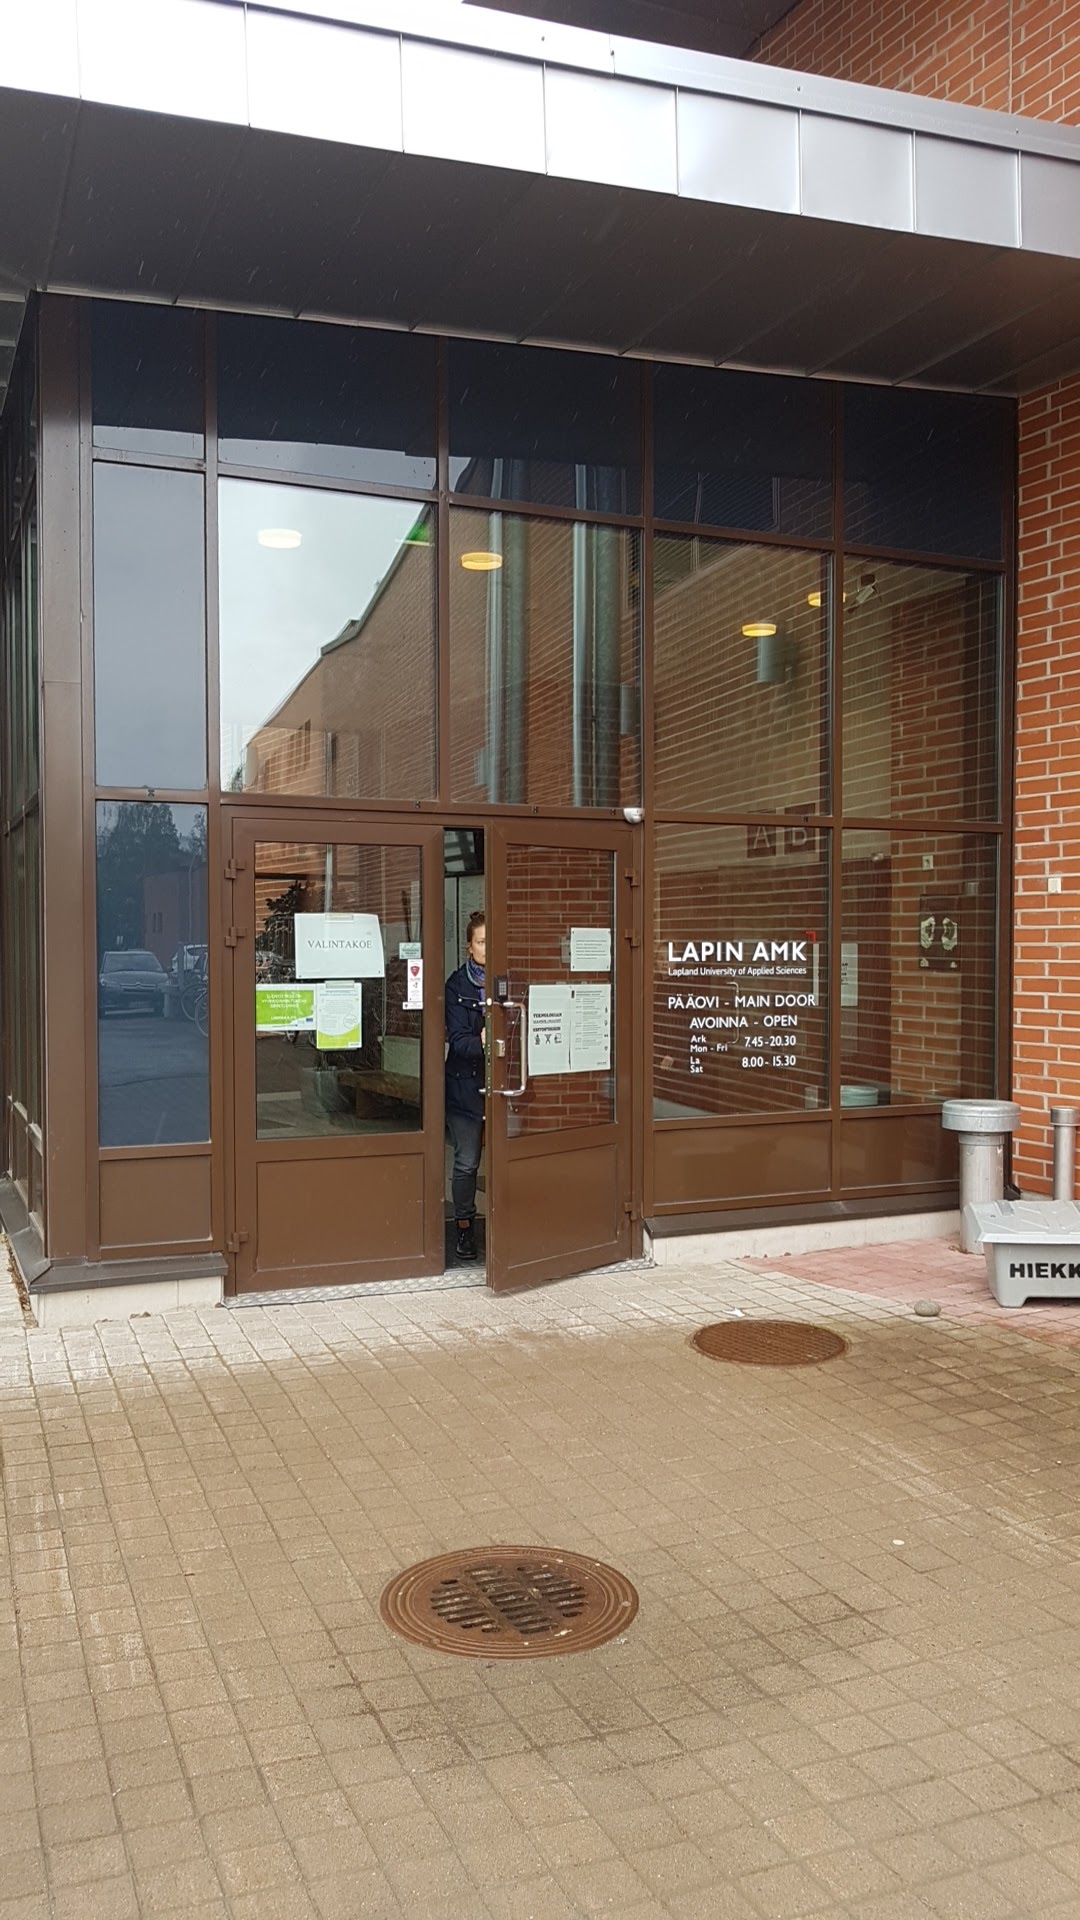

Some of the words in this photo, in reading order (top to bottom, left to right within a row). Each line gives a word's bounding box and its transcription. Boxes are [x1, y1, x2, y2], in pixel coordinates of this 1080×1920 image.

[307, 939, 372, 949] VALINTAKOE
[668, 941, 744, 962] LAPIN
[751, 941, 808, 962] AMK
[668, 967, 699, 977] Lapland
[700, 966, 737, 977] University
[738, 966, 747, 976] of
[747, 966, 775, 976] Applied
[775, 965, 807, 975] Sciences
[668, 993, 720, 1010] PÄÄOVI
[734, 995, 770, 1008] MAIN
[774, 994, 816, 1008] DOOR
[689, 1016, 749, 1030] AVOINNA
[763, 1015, 798, 1028] OPEN
[690, 1035, 707, 1044] Ark
[690, 1045, 708, 1053] Mon
[716, 1043, 728, 1052] Fri
[690, 1056, 701, 1065] La
[690, 1065, 704, 1074] Sat
